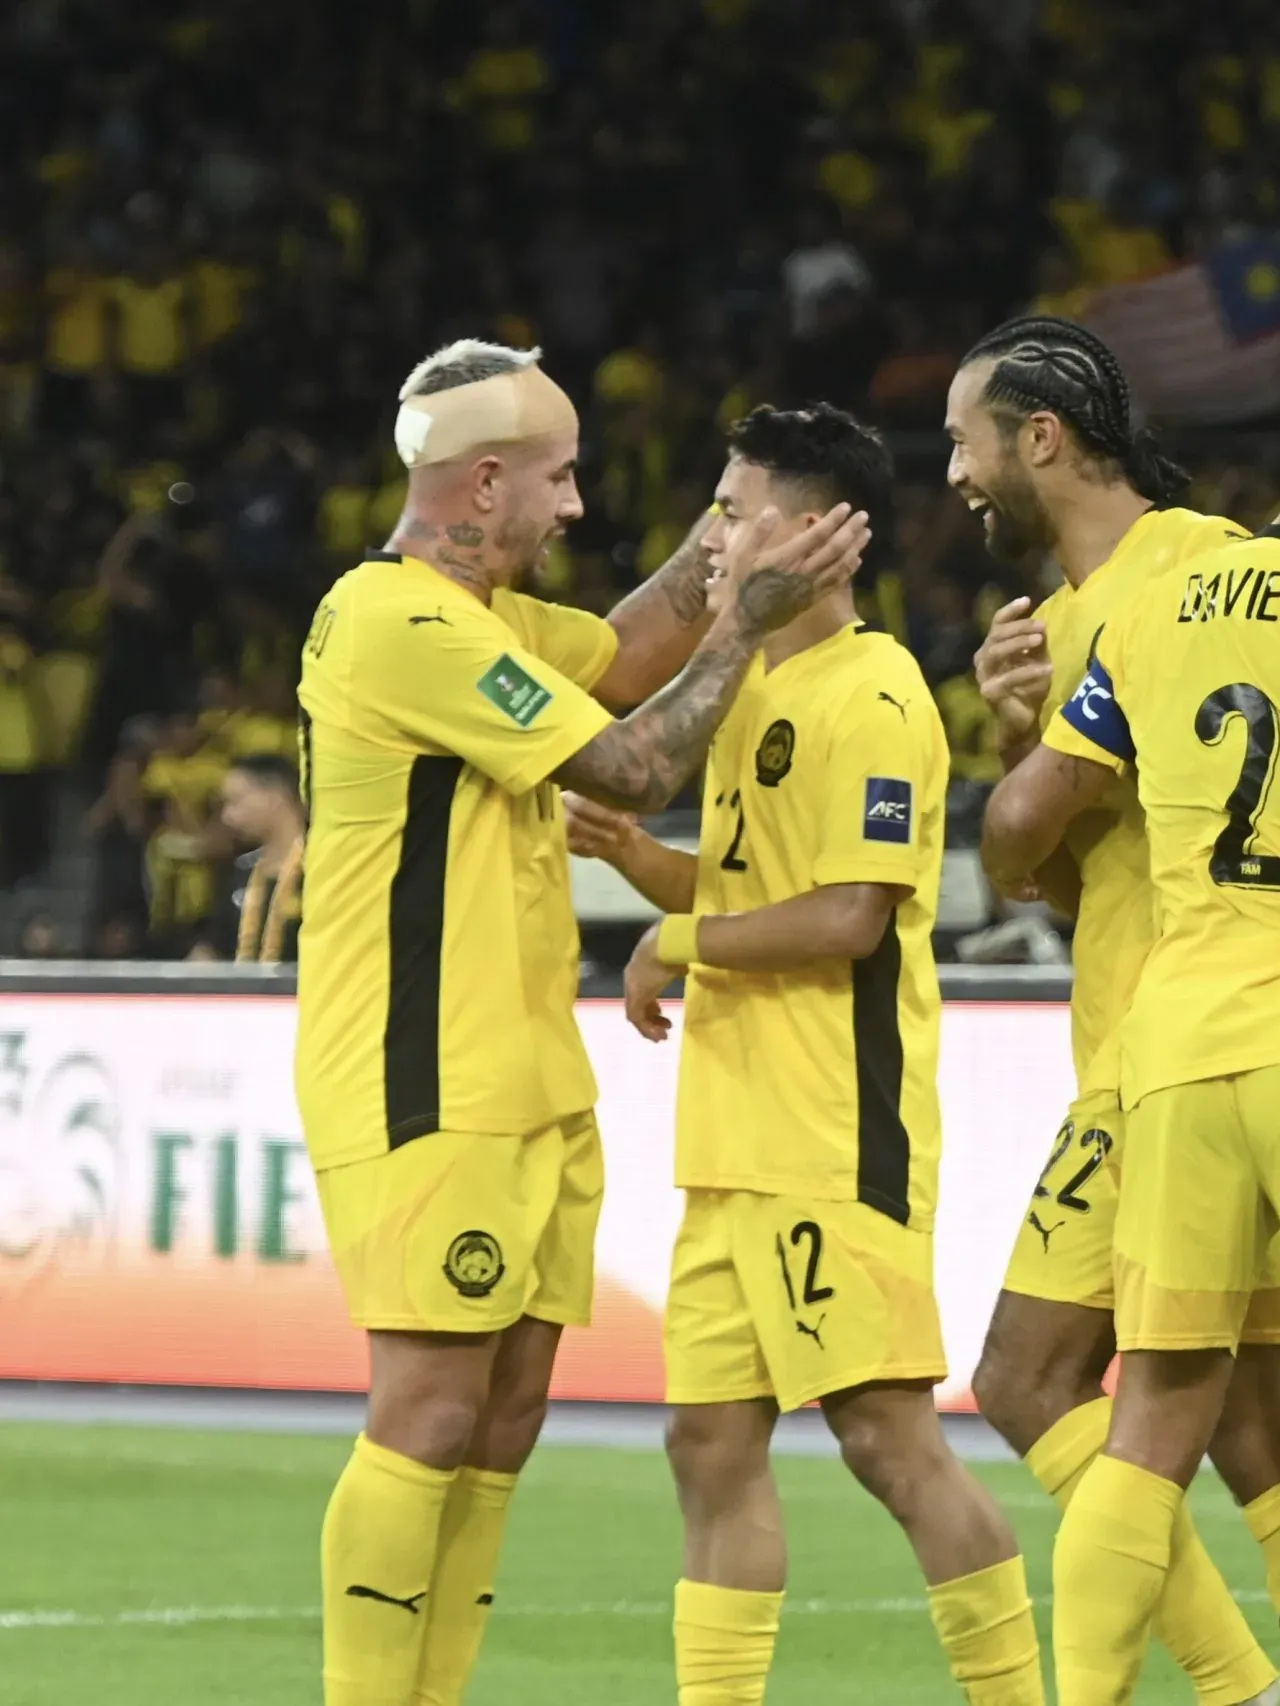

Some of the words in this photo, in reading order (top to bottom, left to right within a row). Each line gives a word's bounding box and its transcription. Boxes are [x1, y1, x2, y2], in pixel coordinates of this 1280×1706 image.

[715, 787, 748, 872] 2
[868, 800, 907, 820] AFC
[1033, 1119, 1114, 1214] 22
[775, 1220, 834, 1311] 12
